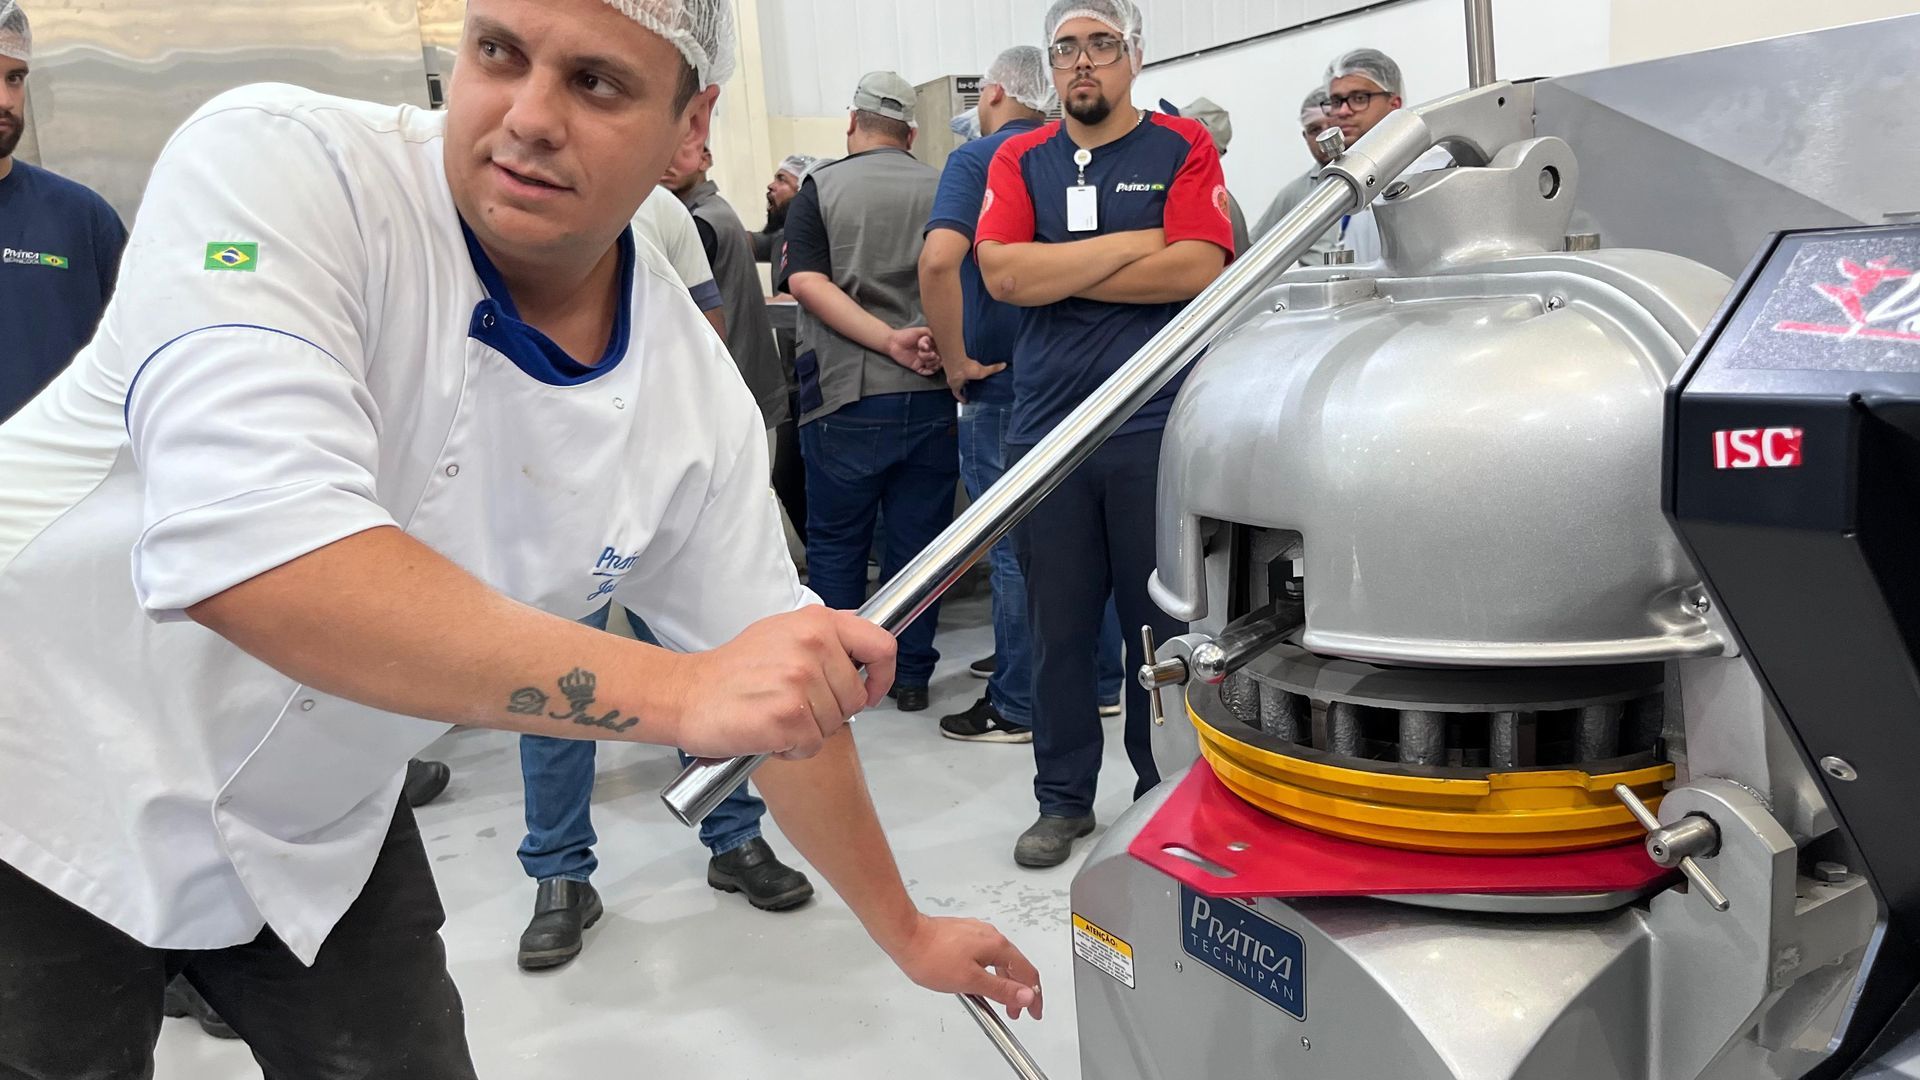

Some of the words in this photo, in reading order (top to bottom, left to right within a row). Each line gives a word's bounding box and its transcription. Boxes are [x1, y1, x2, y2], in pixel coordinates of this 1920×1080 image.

[1715, 427, 1794, 469] ISC
[1190, 895, 1293, 981] PRÁTICA
[1191, 932, 1294, 1002] TECHNIPAN
